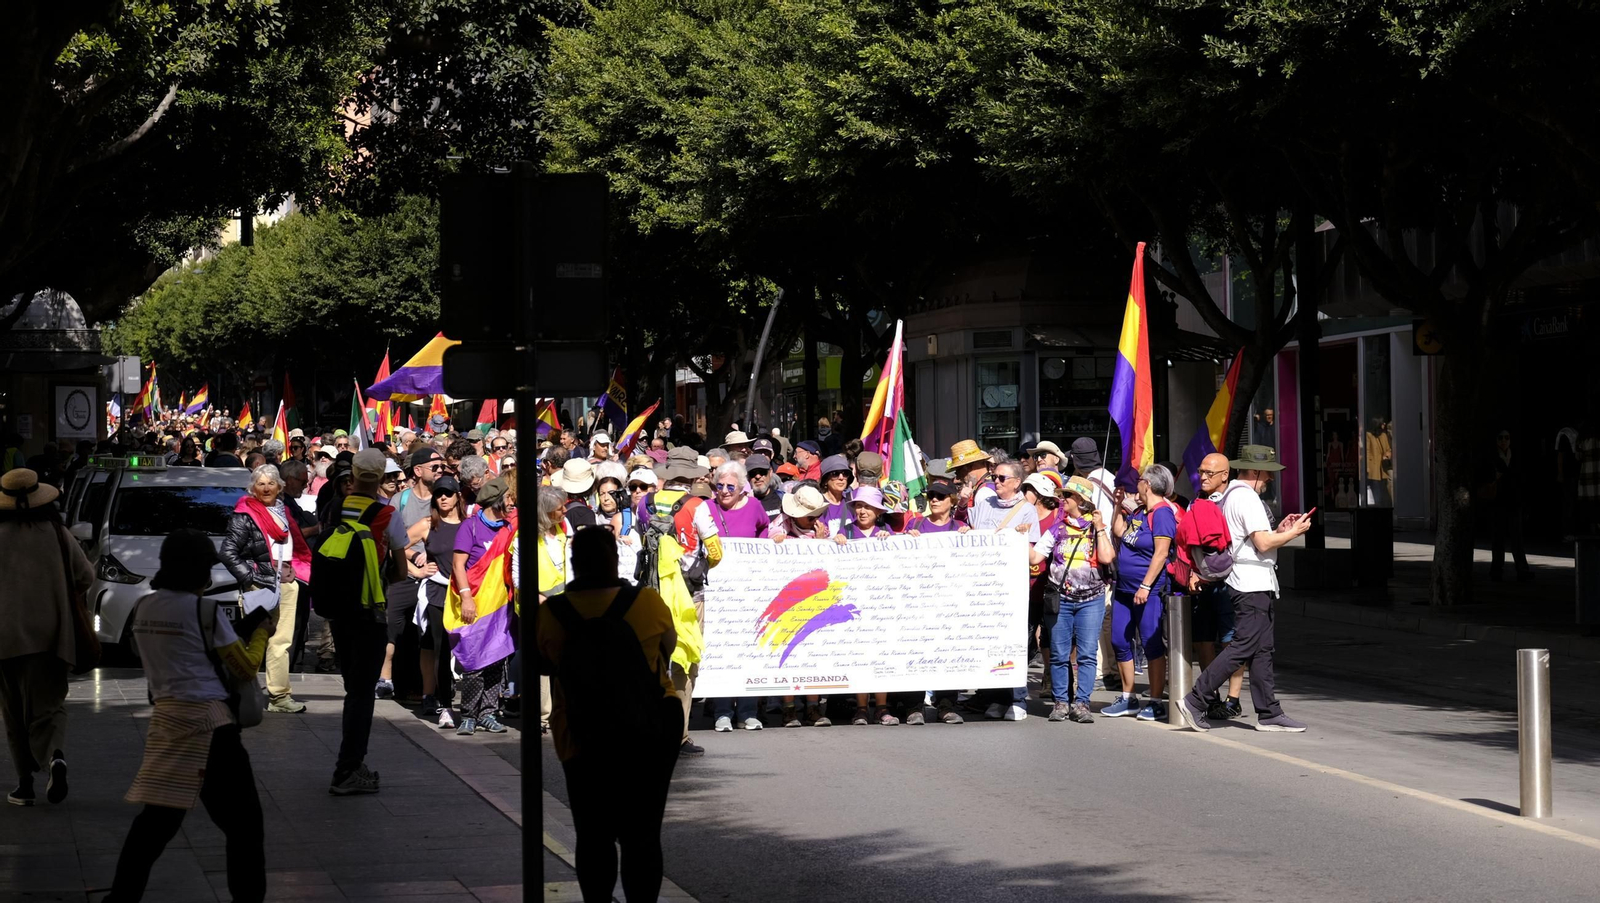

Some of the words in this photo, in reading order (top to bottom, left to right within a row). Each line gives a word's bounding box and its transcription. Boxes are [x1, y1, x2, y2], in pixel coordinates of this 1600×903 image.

[1533, 315, 1568, 335] CaixaBank
[773, 544, 794, 555] DE
[795, 543, 814, 555] LA
[817, 540, 900, 555] CARRETERA
[903, 538, 921, 550] DE
[948, 533, 1008, 548] MUERTE
[915, 656, 948, 665] tantas
[745, 677, 768, 685] ASC
[774, 676, 789, 684] LA
